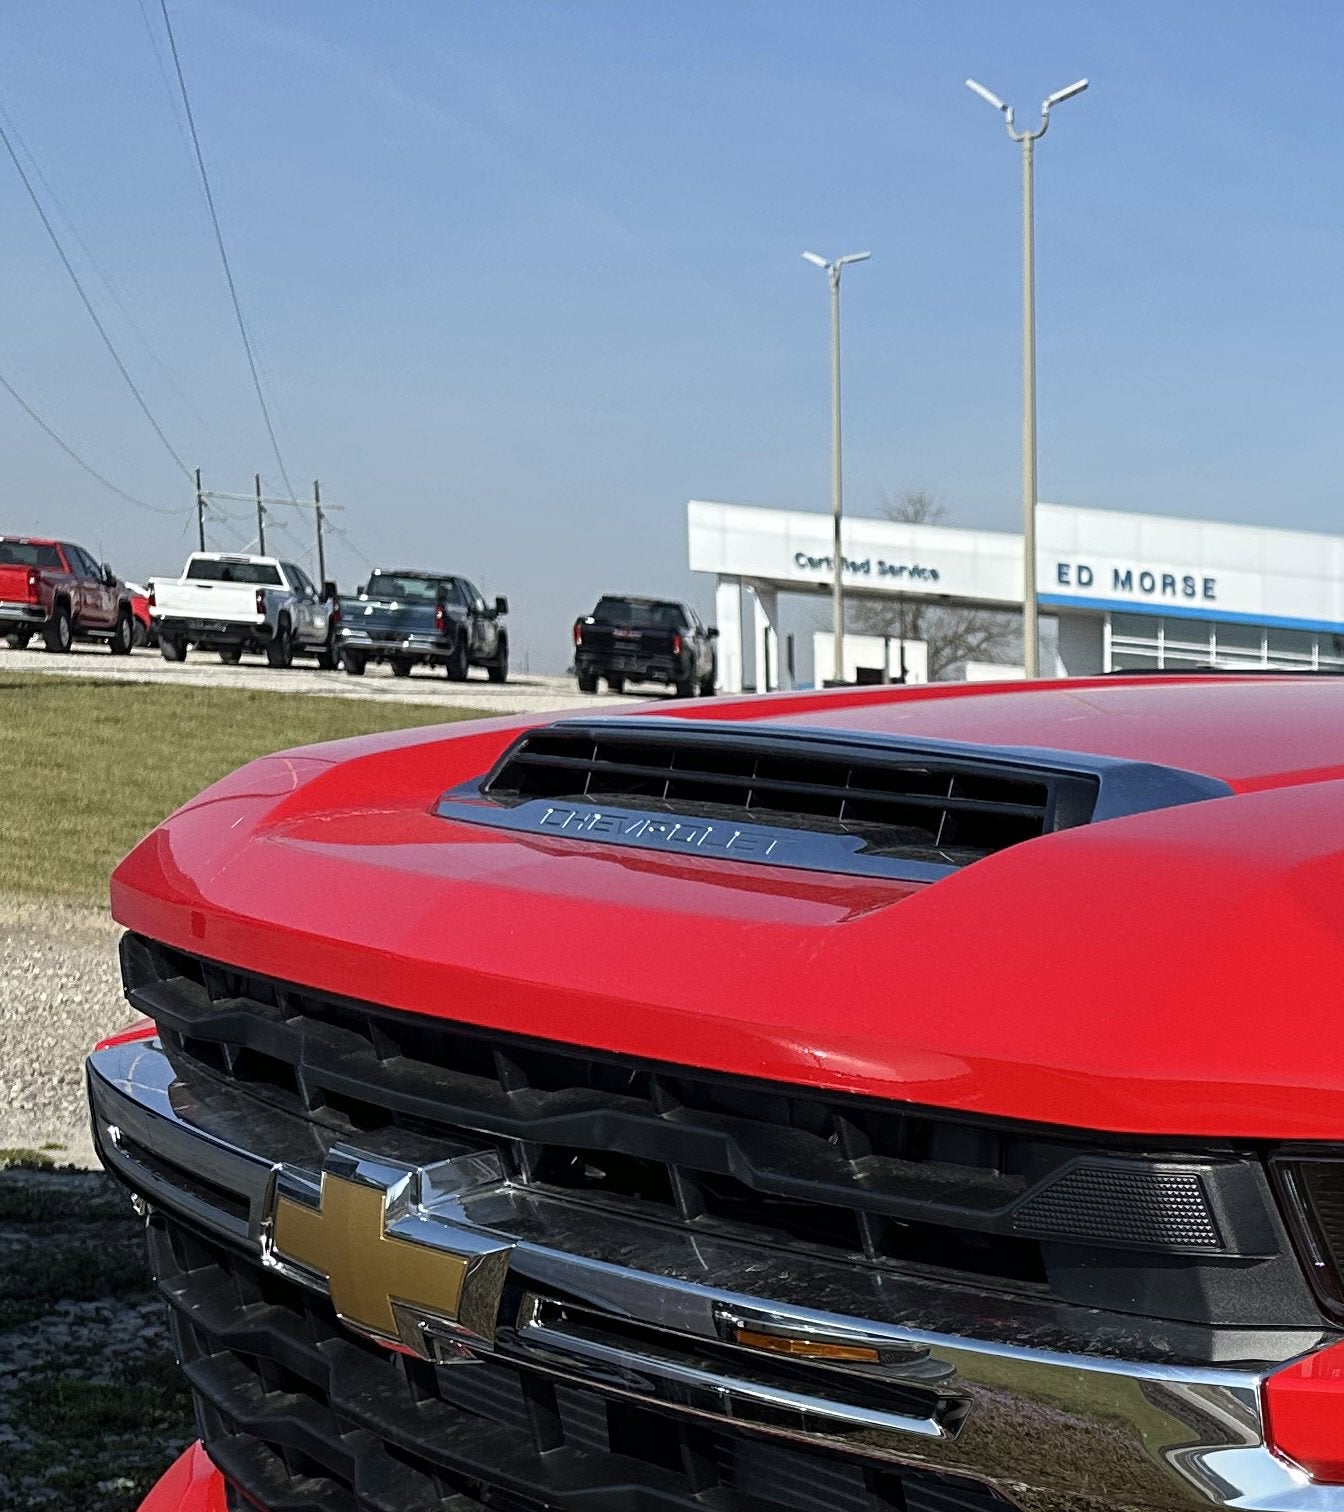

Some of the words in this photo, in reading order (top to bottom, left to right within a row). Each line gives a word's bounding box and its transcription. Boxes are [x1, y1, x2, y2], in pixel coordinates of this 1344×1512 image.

[795, 552, 870, 575] Certfied
[877, 560, 940, 581] Service
[1057, 562, 1094, 587] ED
[1113, 568, 1217, 600] MORSE
[540, 808, 796, 856] CHEVROLET
